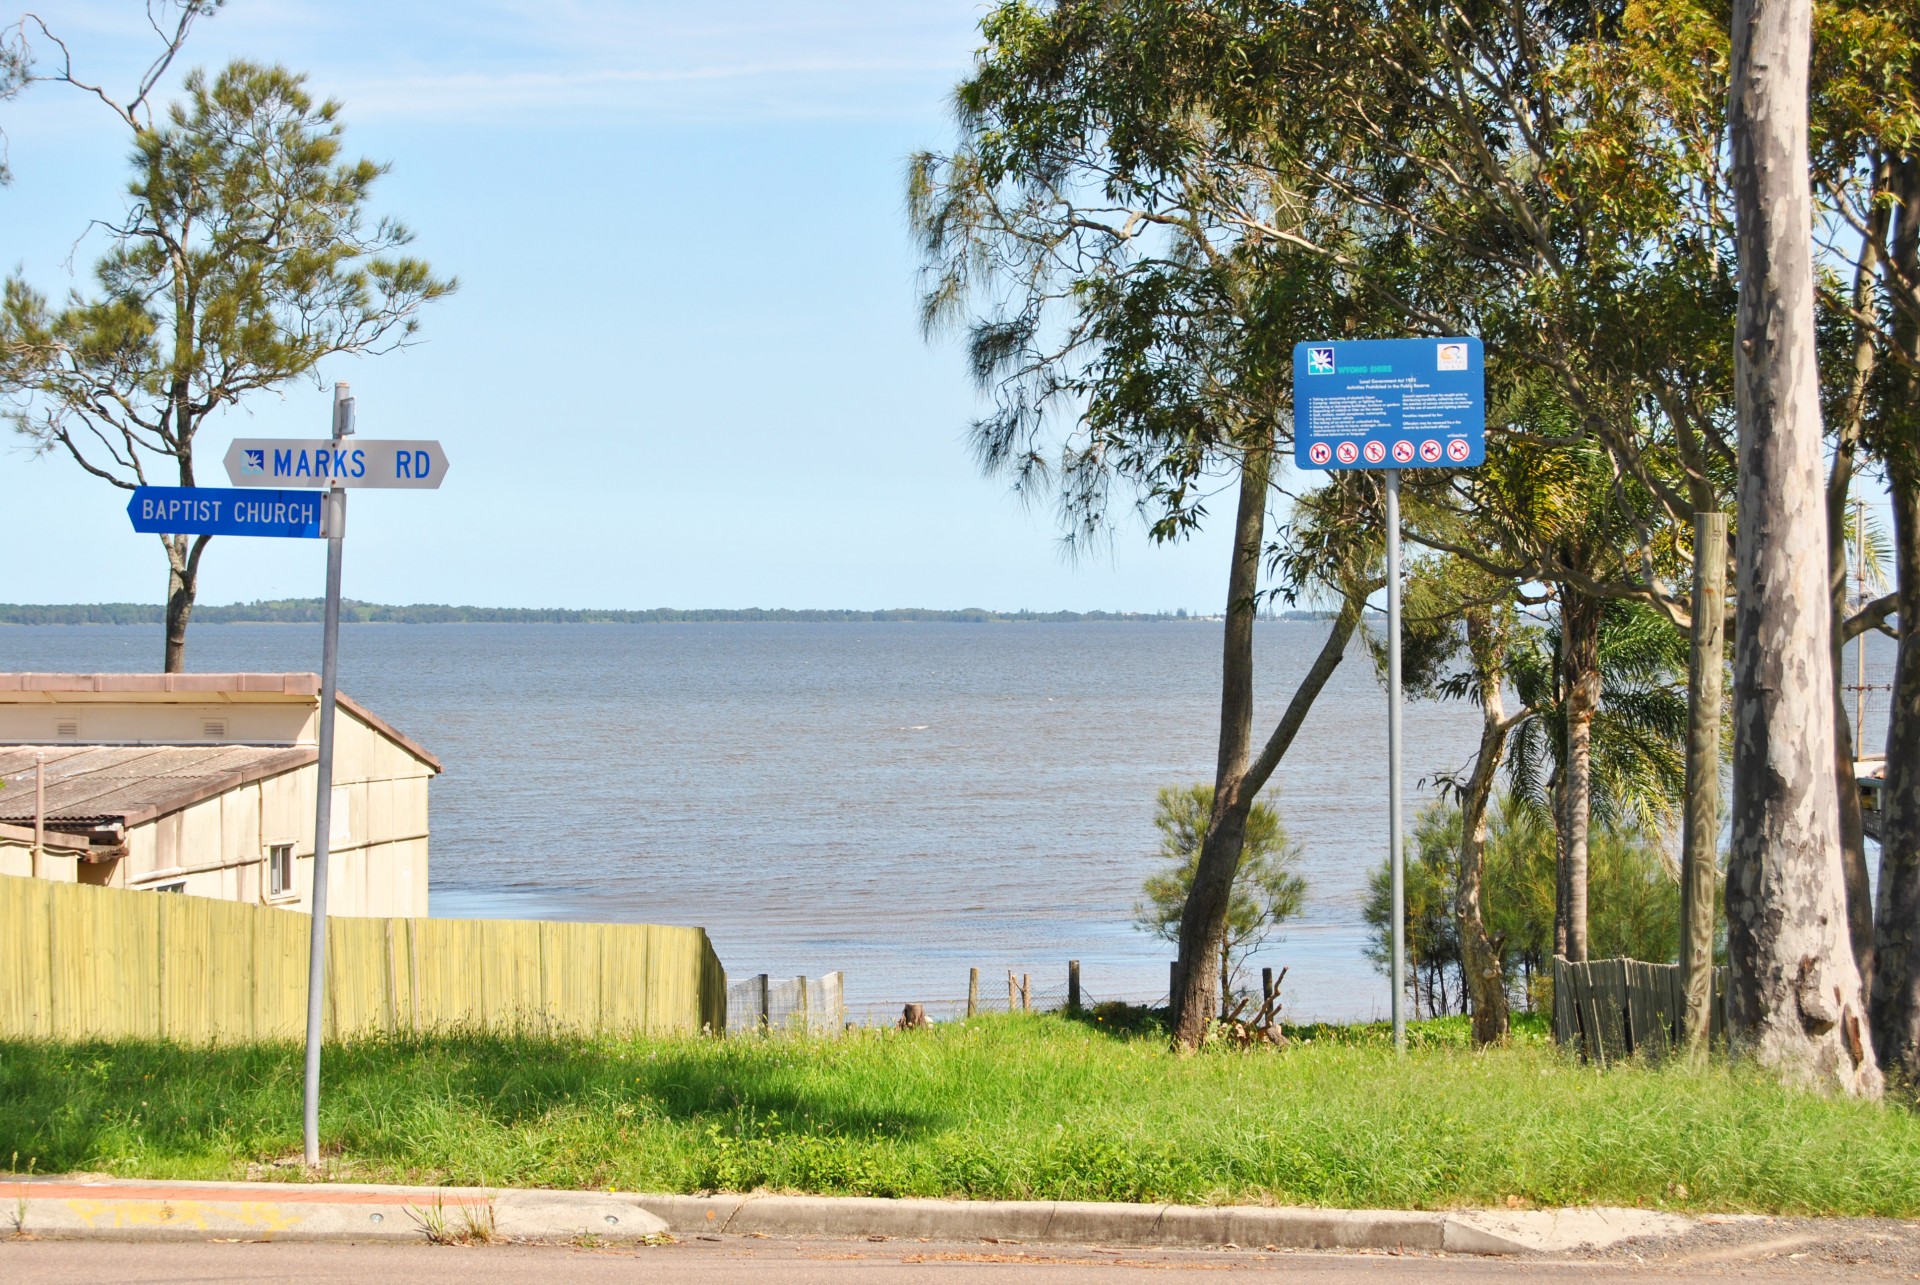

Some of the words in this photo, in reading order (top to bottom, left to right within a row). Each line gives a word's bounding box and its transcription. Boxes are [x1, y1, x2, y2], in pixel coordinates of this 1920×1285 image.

[1337, 366, 1368, 374] WYONG
[1370, 365, 1392, 373] SHIRE
[274, 448, 366, 478] MARKS
[395, 450, 430, 479] RD
[142, 499, 222, 522] BAPTIST
[234, 502, 313, 525] CHURCH
